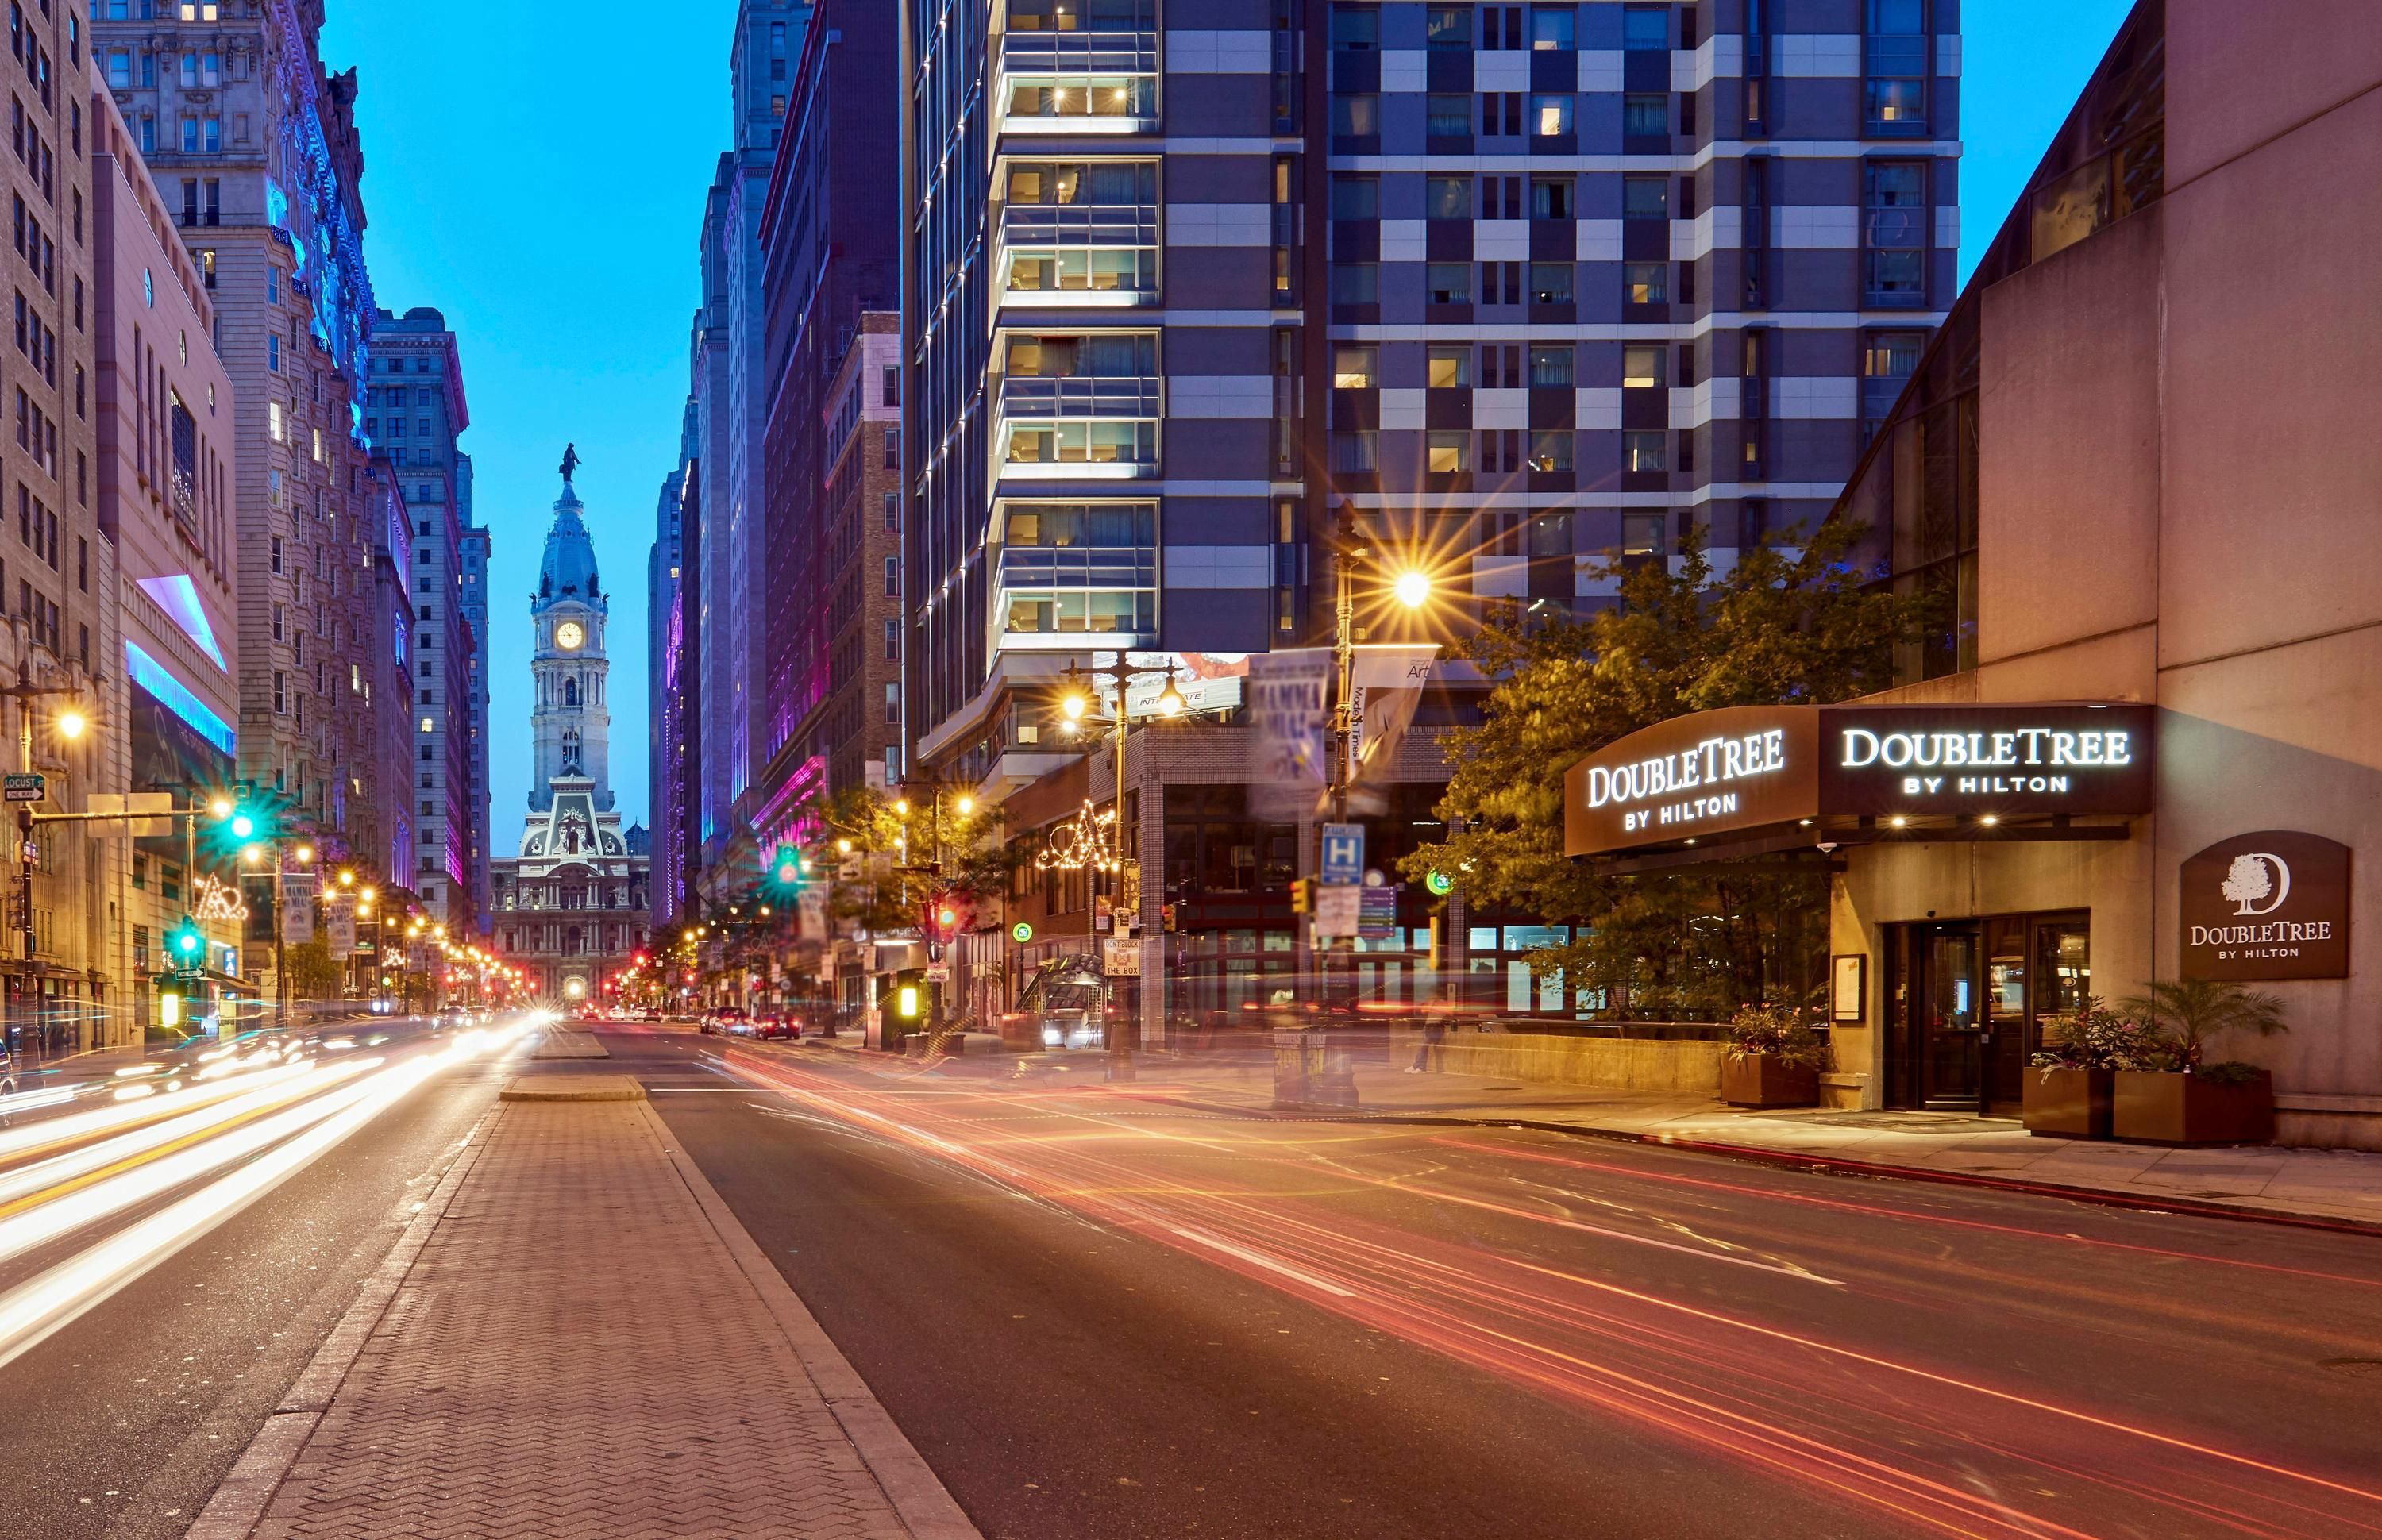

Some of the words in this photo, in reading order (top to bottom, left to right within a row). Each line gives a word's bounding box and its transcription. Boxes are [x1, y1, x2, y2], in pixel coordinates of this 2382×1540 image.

[1407, 665, 1430, 679] Art
[1139, 693, 1201, 706] INTEATE
[1352, 687, 1363, 726] Moden
[1352, 729, 1361, 757] Times
[5, 778, 34, 787] LOCUST
[1903, 777, 1942, 794] BY
[1960, 776, 2068, 793] HILTON
[1625, 812, 1649, 831] BY
[1659, 794, 1736, 826] HILTON
[1330, 838, 1355, 864] H
[2245, 949, 2299, 958] HILTON
